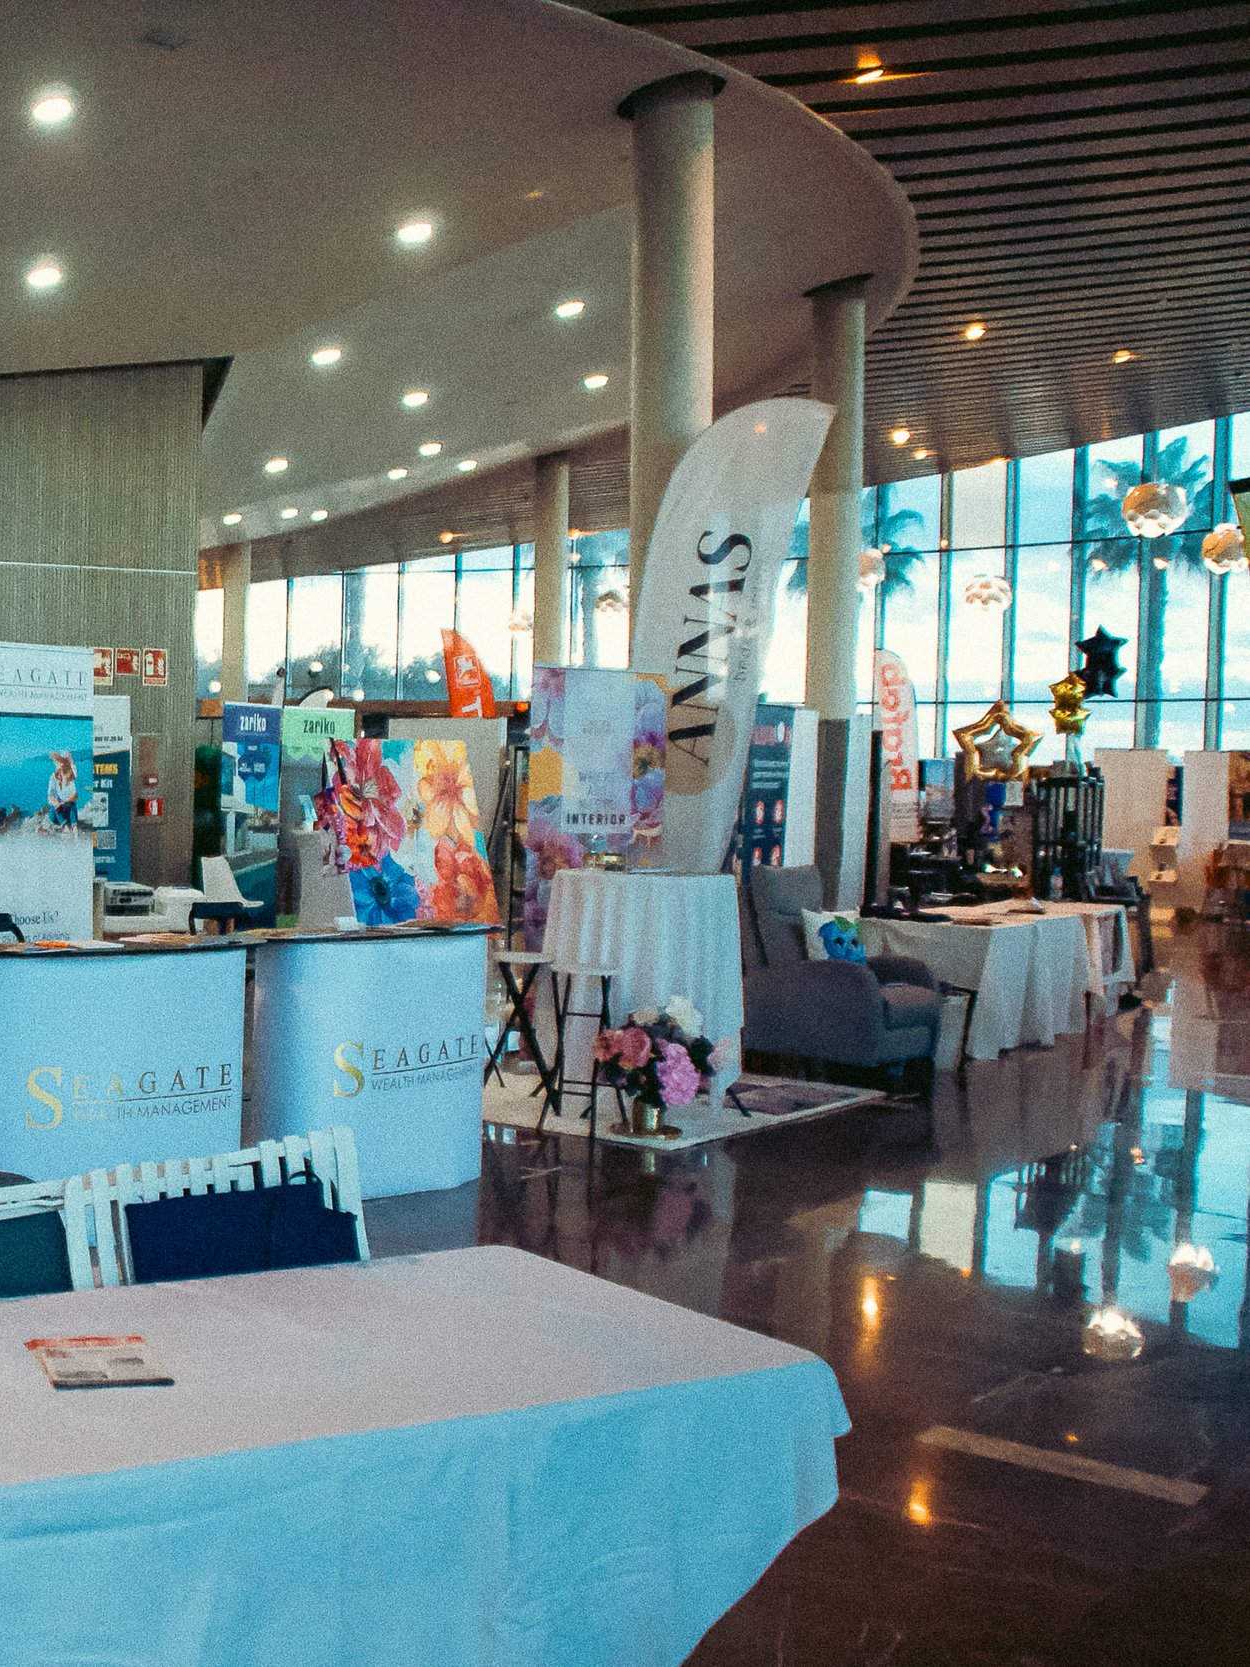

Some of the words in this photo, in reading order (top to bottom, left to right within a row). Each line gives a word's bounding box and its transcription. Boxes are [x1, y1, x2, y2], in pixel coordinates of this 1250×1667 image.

[667, 530, 752, 767] ANNAS
[239, 713, 267, 732] zariko
[303, 718, 336, 735] zariko
[566, 813, 627, 825] INTERIOR
[14, 912, 40, 925] hoose
[334, 1034, 479, 1098] SEAGATE
[25, 1063, 232, 1130] SEAGATE
[137, 1095, 232, 1118] MANAGEMENT
